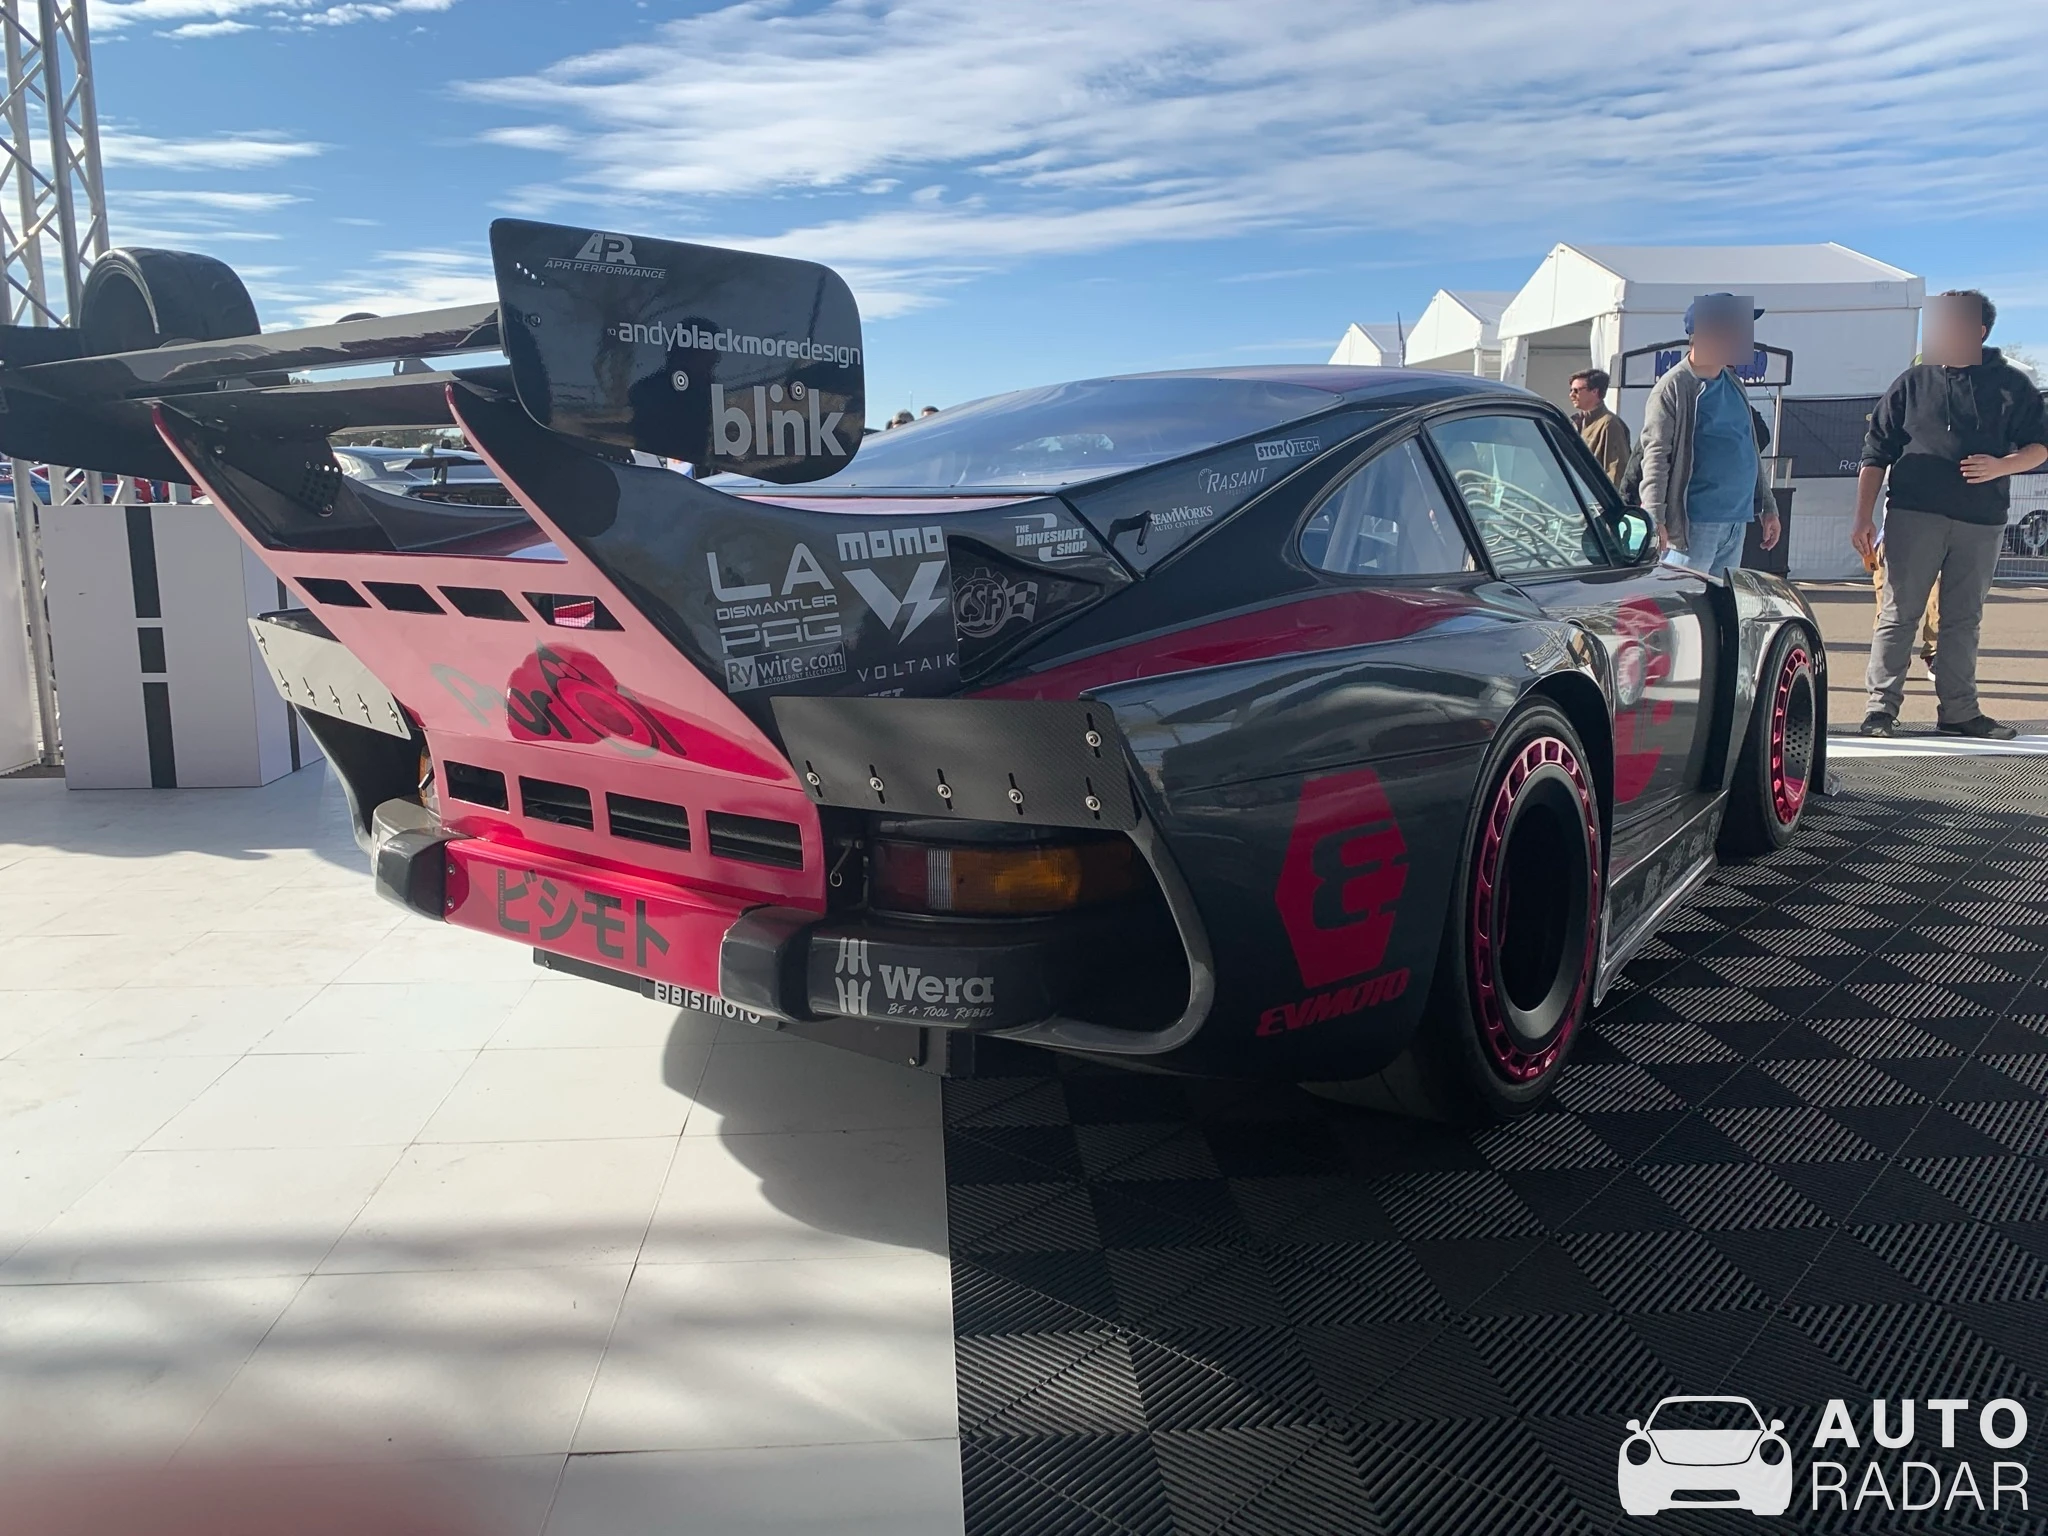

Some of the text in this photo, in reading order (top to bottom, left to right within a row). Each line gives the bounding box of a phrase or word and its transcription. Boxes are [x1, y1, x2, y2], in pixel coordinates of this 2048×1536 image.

[544, 259, 666, 279] APR PERFORMANCE
[618, 321, 861, 369] andyblackmoredesign
[710, 383, 847, 456] blink
[1207, 466, 1267, 494] RASANT
[1015, 524, 1030, 534] THE
[1015, 527, 1085, 547] DRIVESHAFT
[1154, 519, 1200, 532] AUTO CENTER
[1056, 540, 1088, 556] SHOP
[706, 542, 835, 602] LA
[716, 594, 838, 621] DISMANTLER
[720, 612, 842, 654] PAG
[804, 664, 846, 678] ELECTRONICS
[857, 652, 957, 682] VOLTAIK
[497, 868, 671, 969] ビシモト
[878, 964, 995, 1004] Wera
[908, 1005, 919, 1016] A
[922, 1005, 950, 1018] TOOL
[1256, 967, 1411, 1037] EVMOTO
